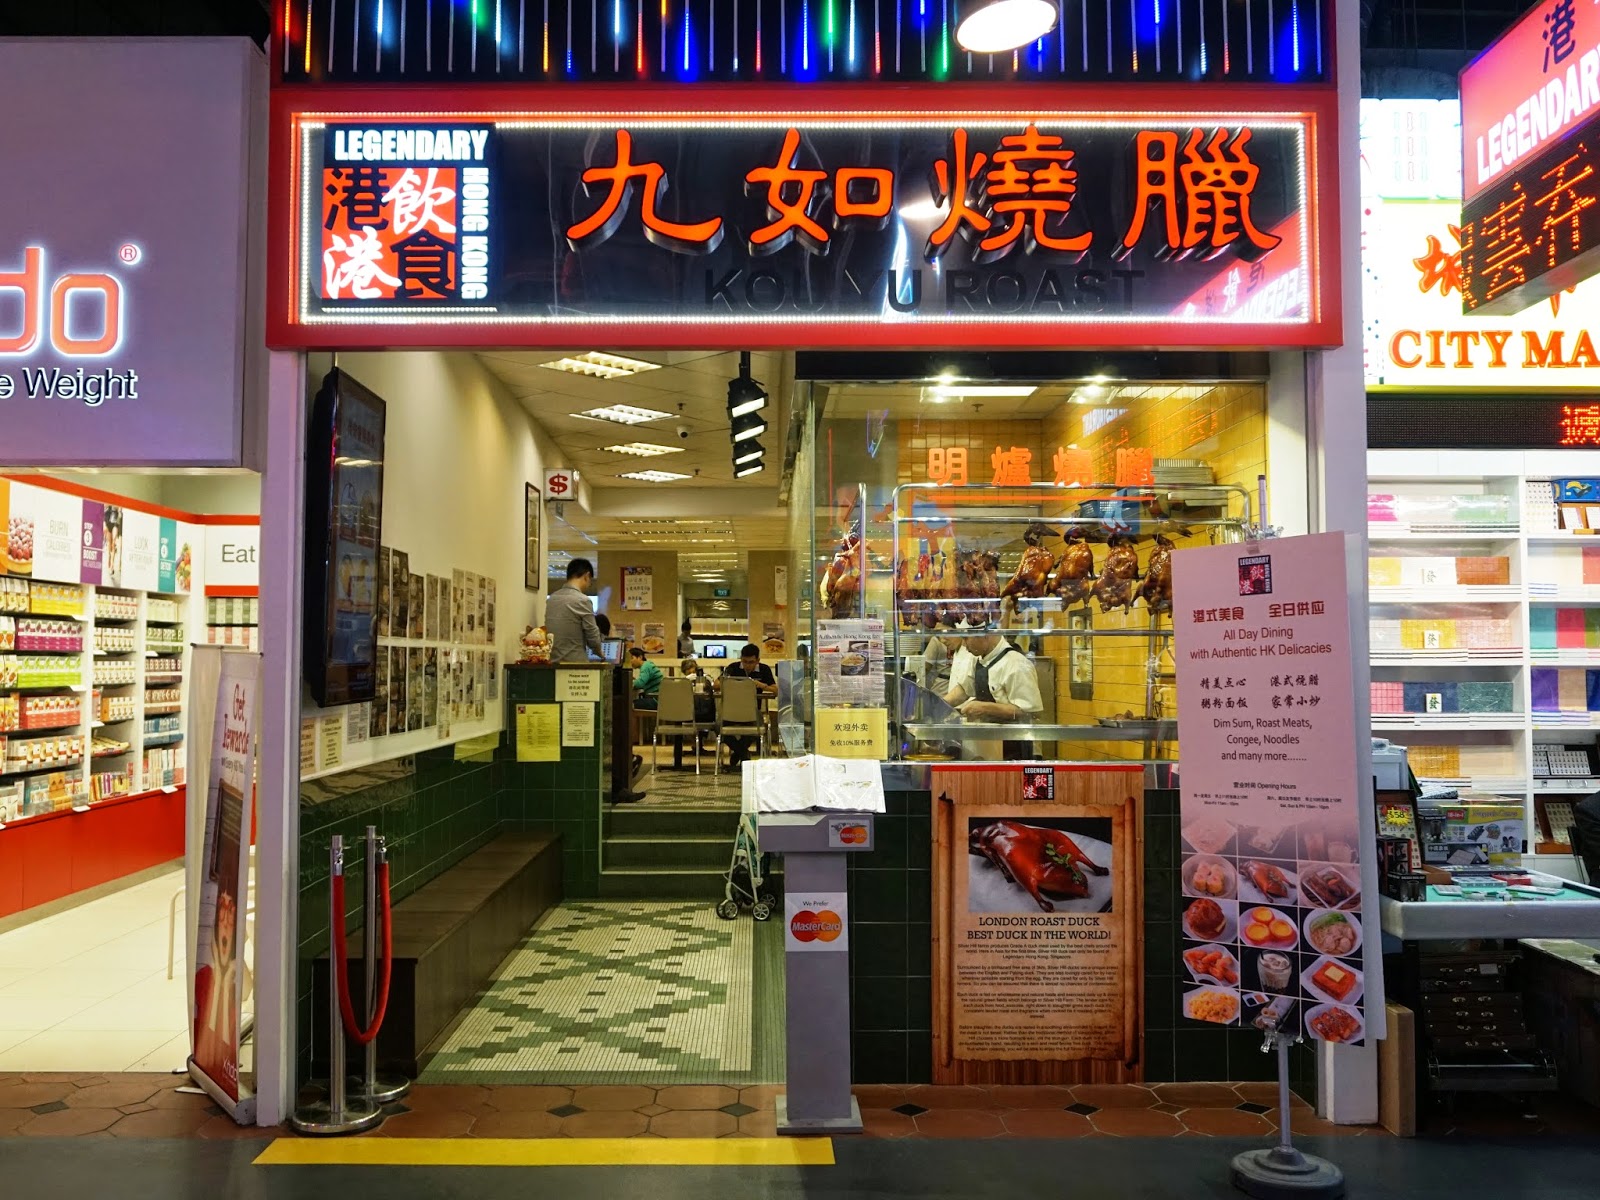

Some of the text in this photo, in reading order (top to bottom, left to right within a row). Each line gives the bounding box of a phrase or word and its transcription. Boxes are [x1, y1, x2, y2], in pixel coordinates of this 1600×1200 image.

[1477, 44, 1600, 185] LEGENDAR
[335, 129, 489, 161] LEGENDARY
[461, 167, 489, 300] HONG KONG
[945, 269, 1146, 313] ROAST
[1388, 328, 1600, 369] CITY MA
[22, 367, 138, 407] Weight
[221, 543, 256, 564] Eat
[1240, 556, 1270, 566] LEGENDARY
[1193, 600, 1325, 623] 港式美食 全日供应
[1223, 627, 1294, 642] All Day Dining
[1190, 642, 1332, 660] with Authentic HK Delicacies
[833, 723, 869, 732] 欢迎外卖
[1213, 718, 1313, 730] Dim Sum, Roast Meats,
[1226, 734, 1300, 747] Congee, Noodles
[1221, 751, 1237, 761] and
[1238, 752, 1262, 763] many
[792, 921, 840, 931] MasterCard
[979, 917, 1100, 926] LONDON ROAST DUCK
[967, 930, 1112, 940] BEST DUCK IN THE WORLD!
